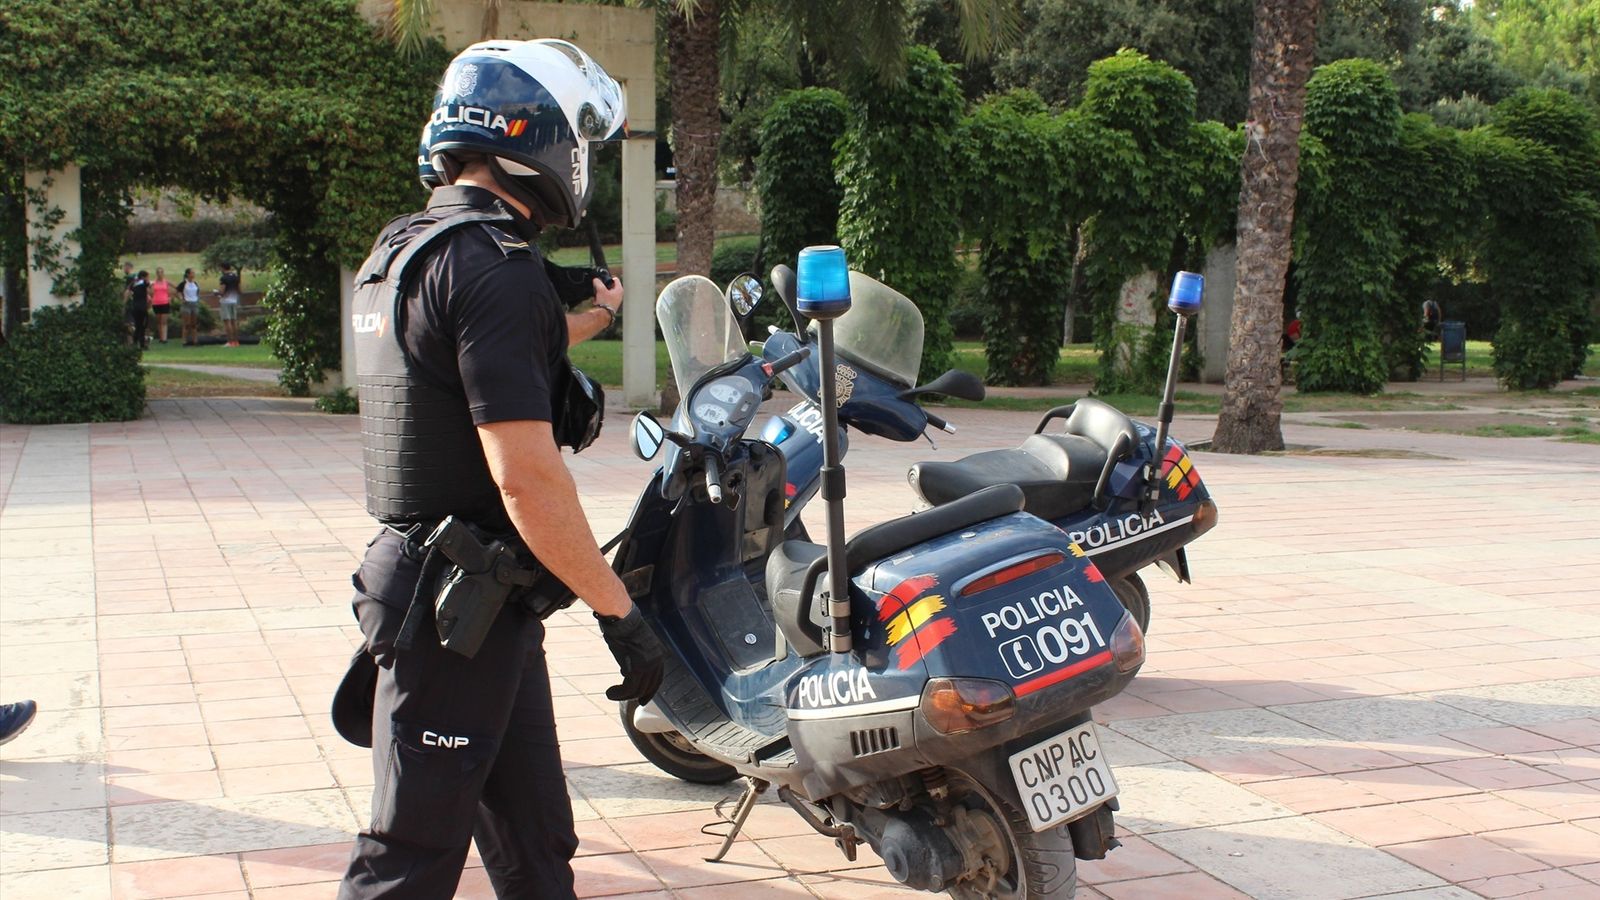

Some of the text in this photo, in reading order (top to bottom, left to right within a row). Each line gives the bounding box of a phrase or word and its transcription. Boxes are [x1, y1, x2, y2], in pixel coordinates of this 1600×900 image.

[571, 148, 580, 195] CNP
[787, 400, 824, 444] LICIA
[1069, 508, 1164, 547] POLICIA
[981, 585, 1083, 638] POLICIA
[1036, 612, 1105, 664] 091
[799, 667, 876, 708] POLICIA
[422, 730, 469, 749] CNP
[1031, 767, 1105, 823] 0300
